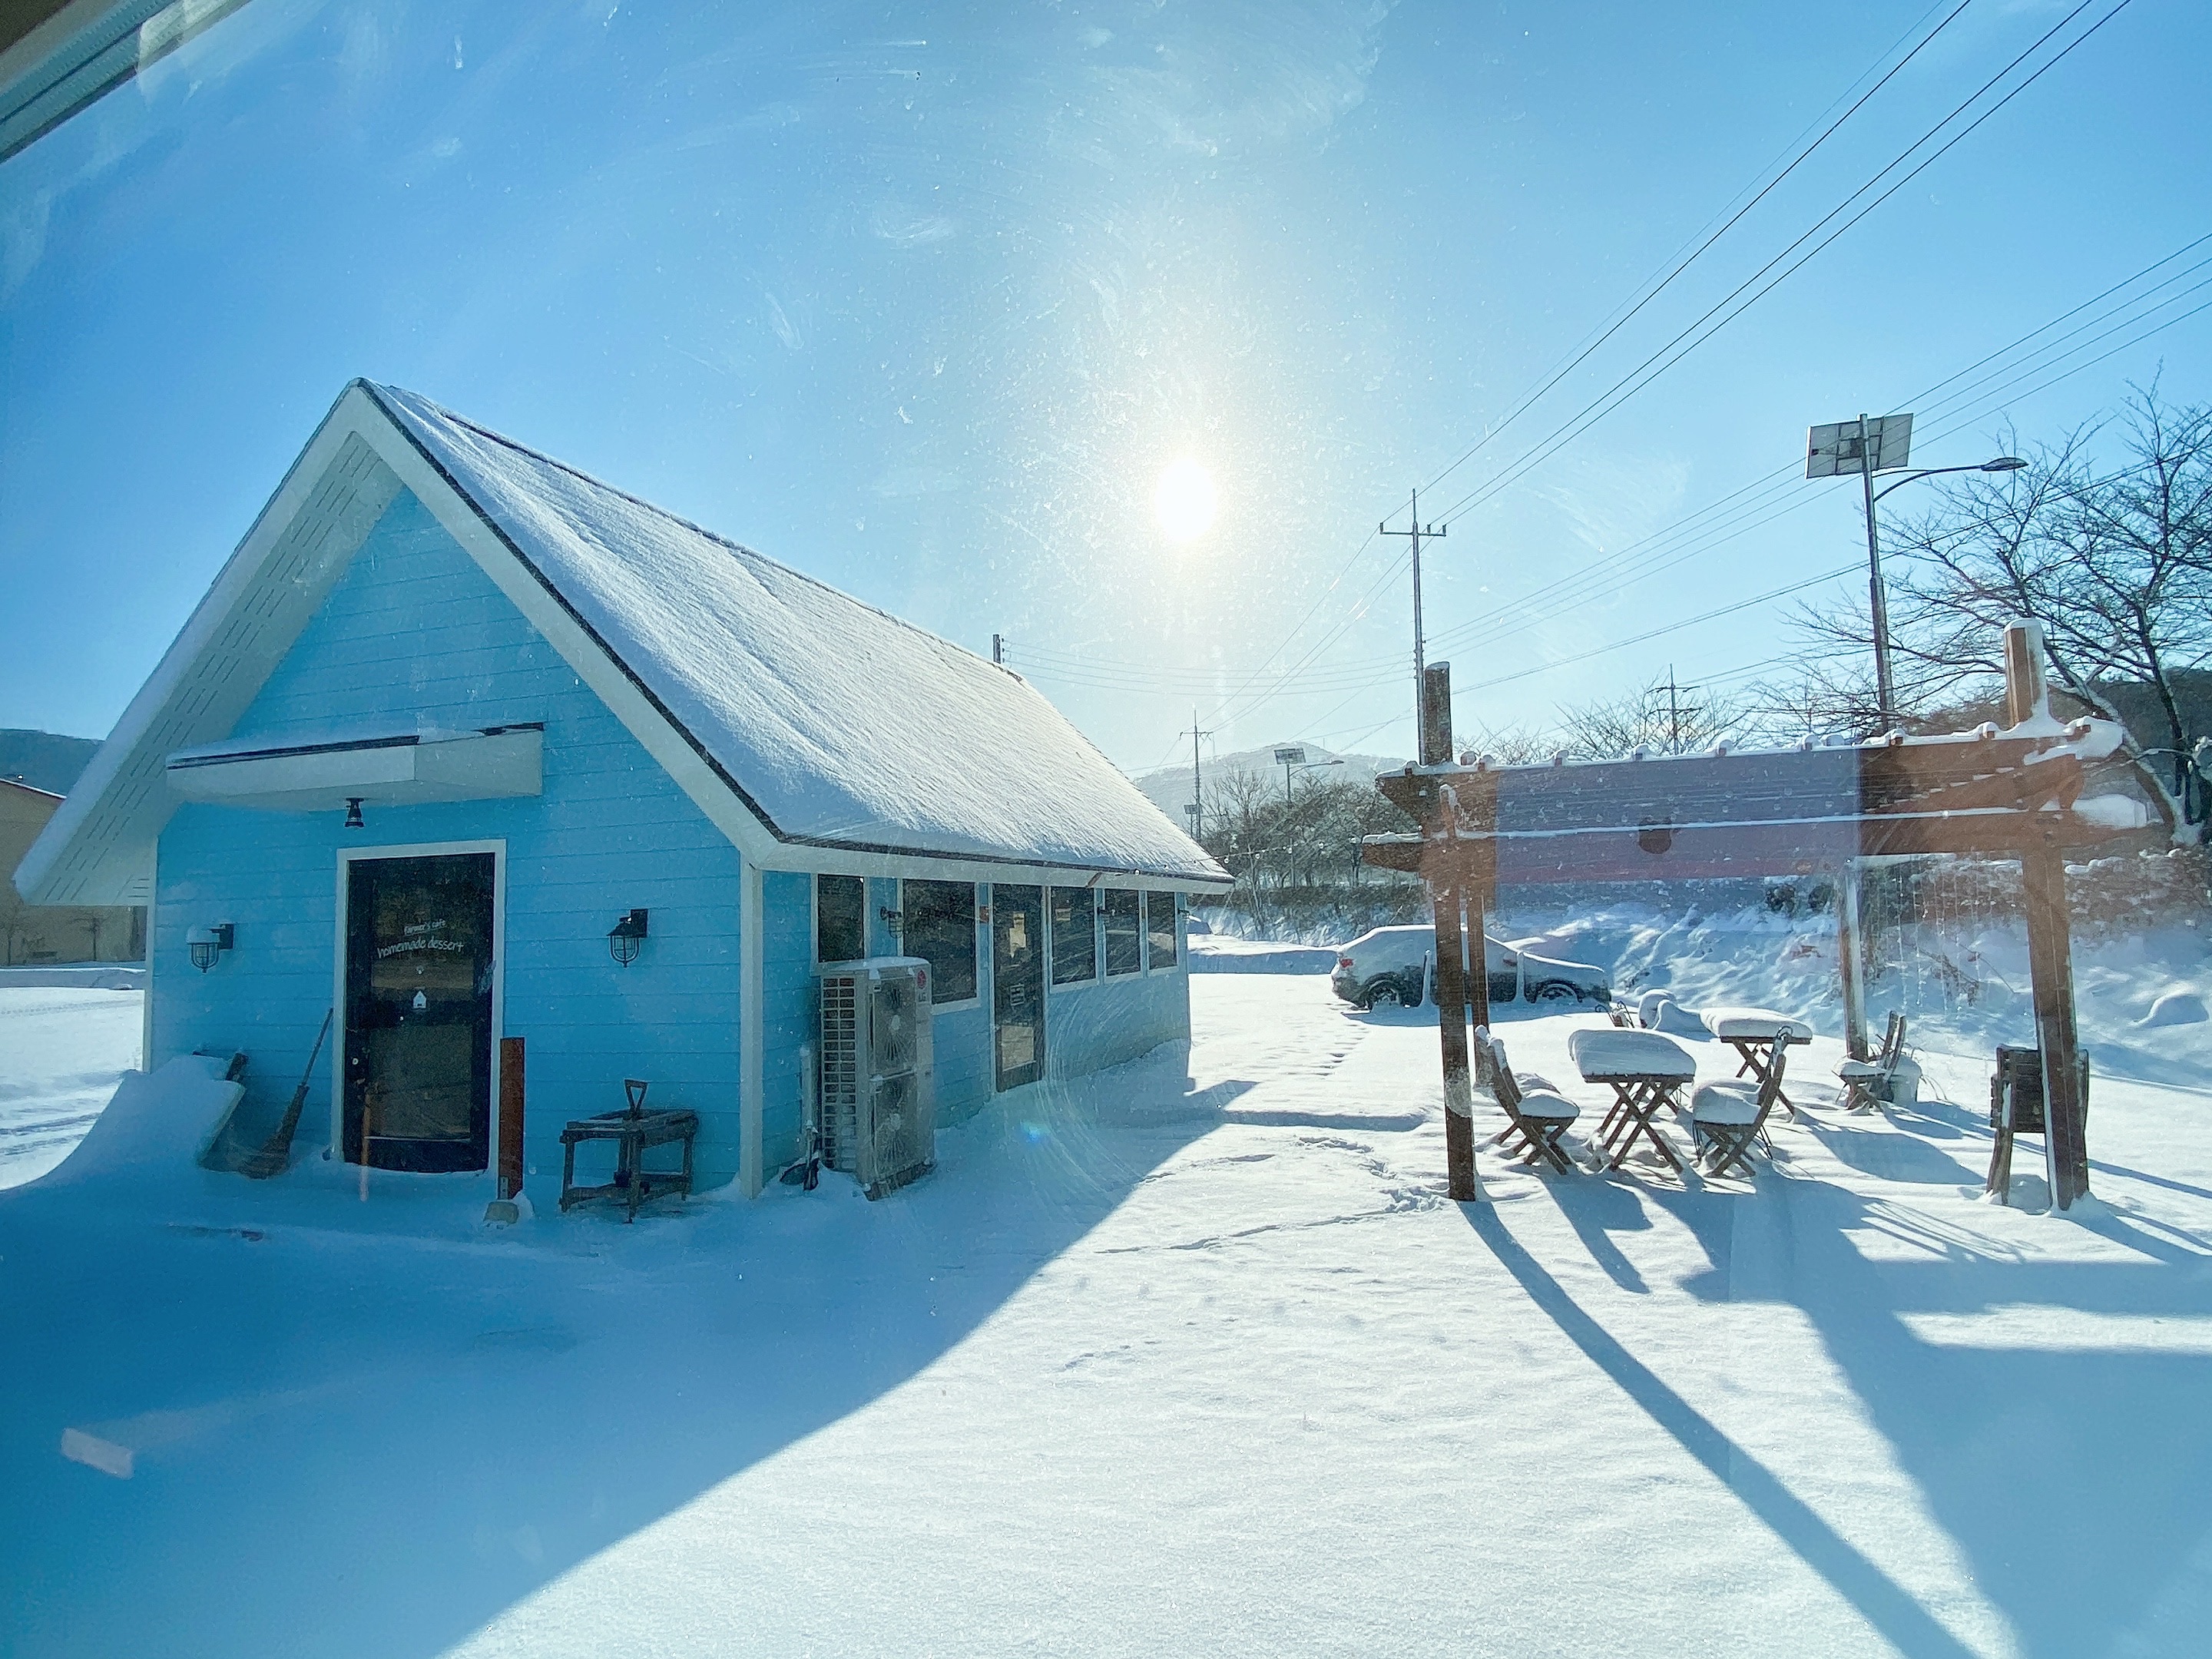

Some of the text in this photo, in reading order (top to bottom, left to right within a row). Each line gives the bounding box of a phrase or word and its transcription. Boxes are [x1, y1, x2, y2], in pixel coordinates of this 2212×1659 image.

[376, 935, 464, 959] homemade dessert
[918, 992, 926, 1002] LG
